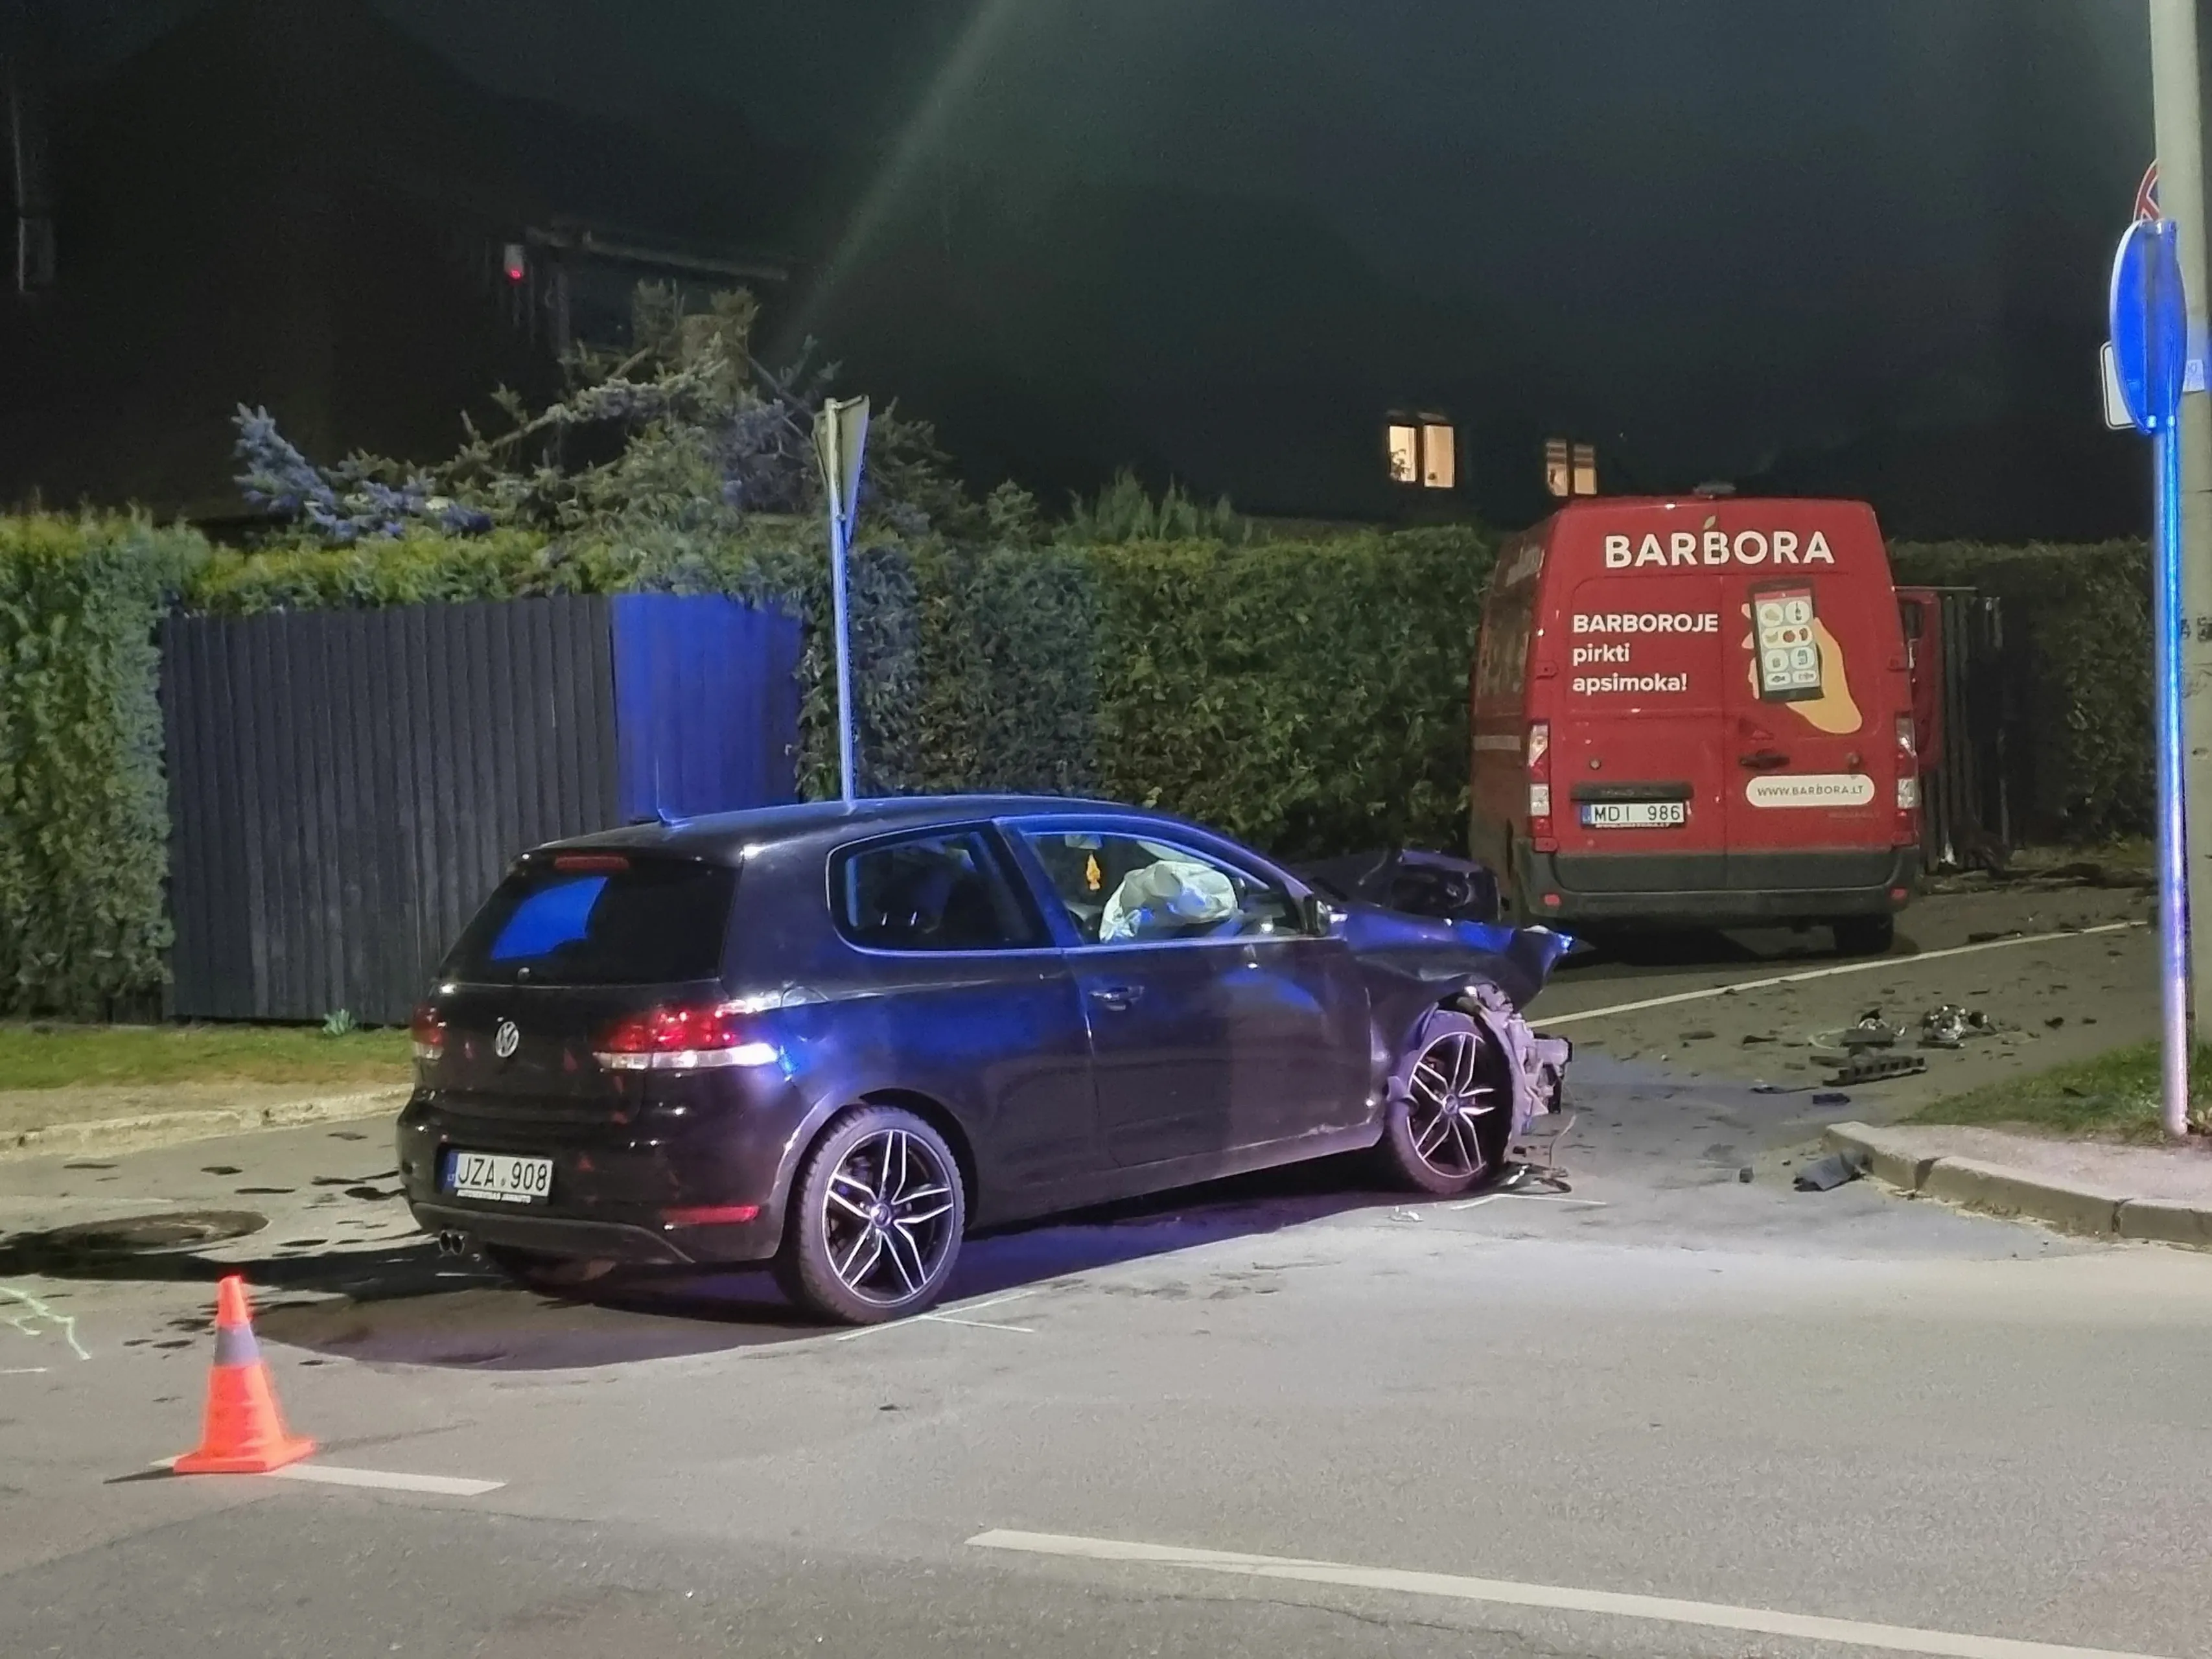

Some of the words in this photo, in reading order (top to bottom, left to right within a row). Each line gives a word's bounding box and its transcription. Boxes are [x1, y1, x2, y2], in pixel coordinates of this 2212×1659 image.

[1605, 530, 1835, 568] BARBORA
[1572, 613, 1719, 633] BARBOROJE
[1572, 643, 1630, 666] pirkti
[1572, 672, 1688, 695] apsimoka!
[1757, 783, 1864, 796] WWW.BARBORA.LT
[1594, 806, 1630, 822] MDI
[1647, 806, 1681, 821] 986
[458, 1157, 496, 1187] JZA
[510, 1161, 548, 1192] 908
